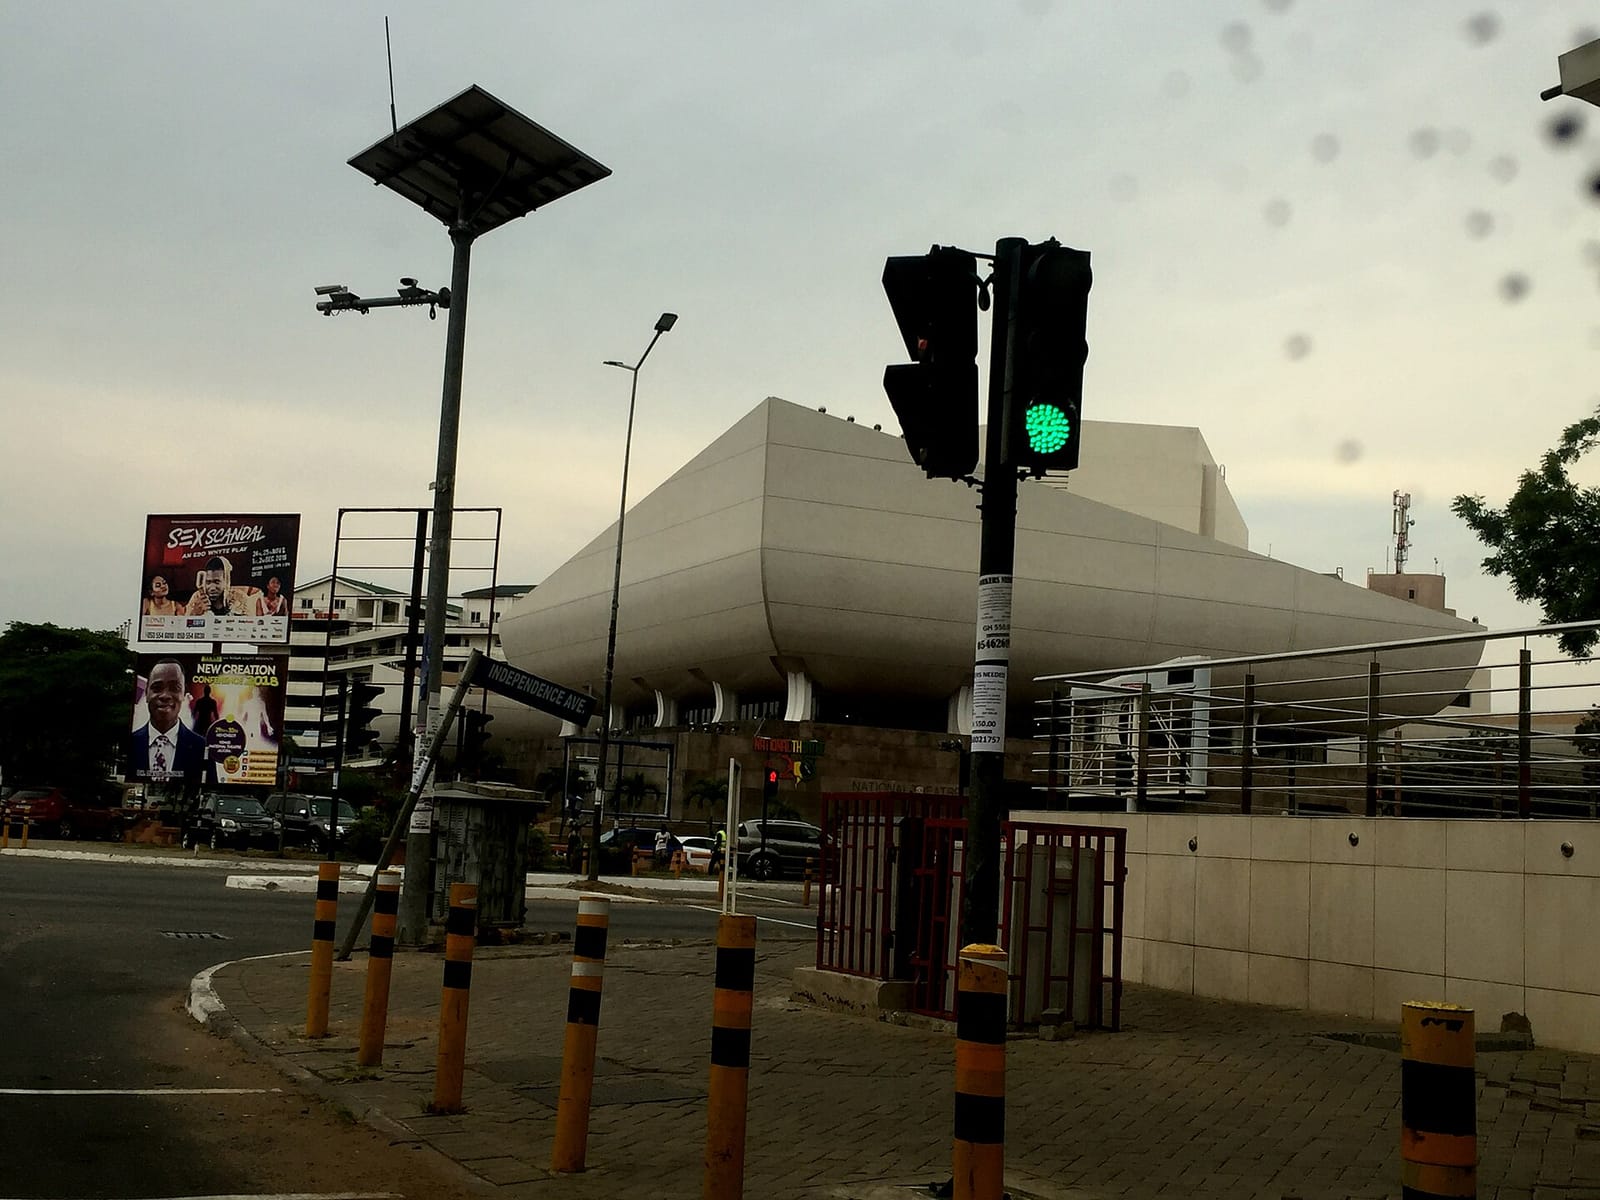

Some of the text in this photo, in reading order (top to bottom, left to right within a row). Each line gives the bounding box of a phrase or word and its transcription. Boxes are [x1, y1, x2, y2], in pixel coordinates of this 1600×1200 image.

[167, 524, 266, 548] SEX SCANDAL
[197, 664, 276, 677] NEW CREATION
[246, 676, 279, 687] 2018
[488, 663, 588, 714] INDEPENDENCE AVE.
